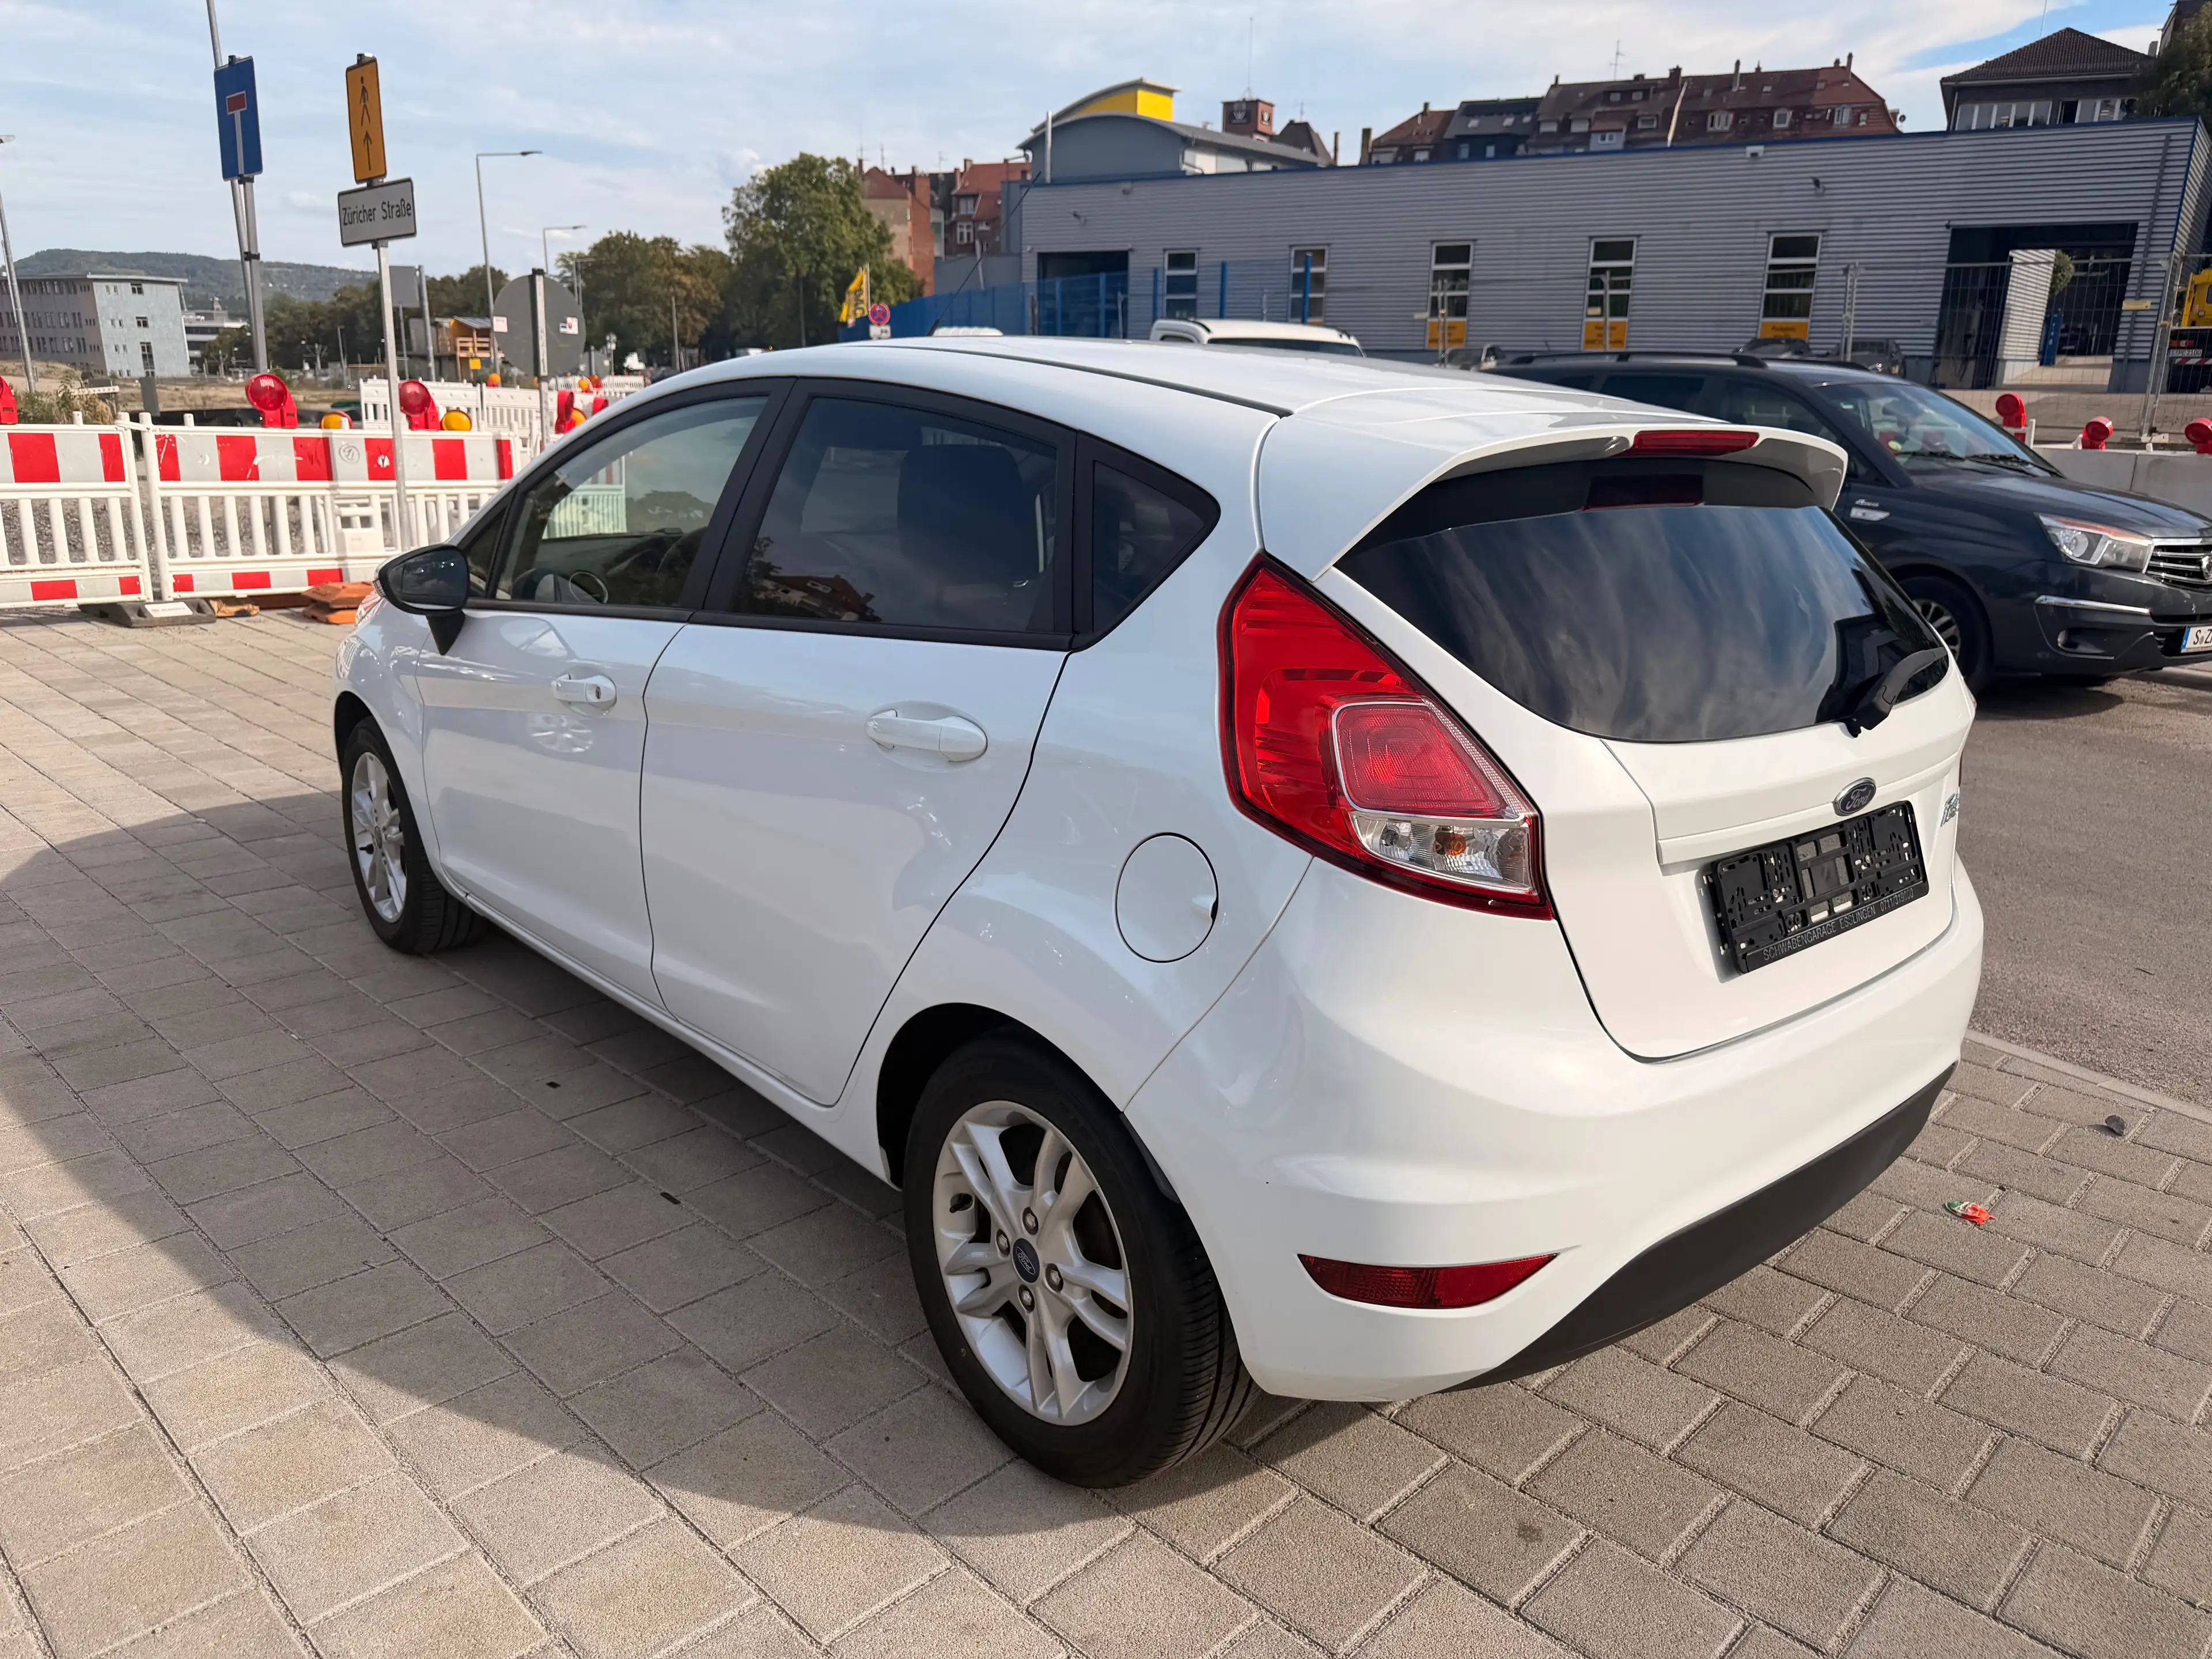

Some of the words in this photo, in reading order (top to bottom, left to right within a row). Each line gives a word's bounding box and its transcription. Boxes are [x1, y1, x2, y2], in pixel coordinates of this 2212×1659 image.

[342, 203, 376, 226] Züricher
[381, 198, 411, 220] Straße
[2193, 630, 2202, 645] S
[2205, 628, 2212, 644] Z
[1846, 787, 1871, 810] Ford
[1763, 922, 1836, 961] SCHWABENGARAGE
[1839, 905, 1876, 929] ESSLINGEN
[1018, 1252, 1032, 1271] Ford
